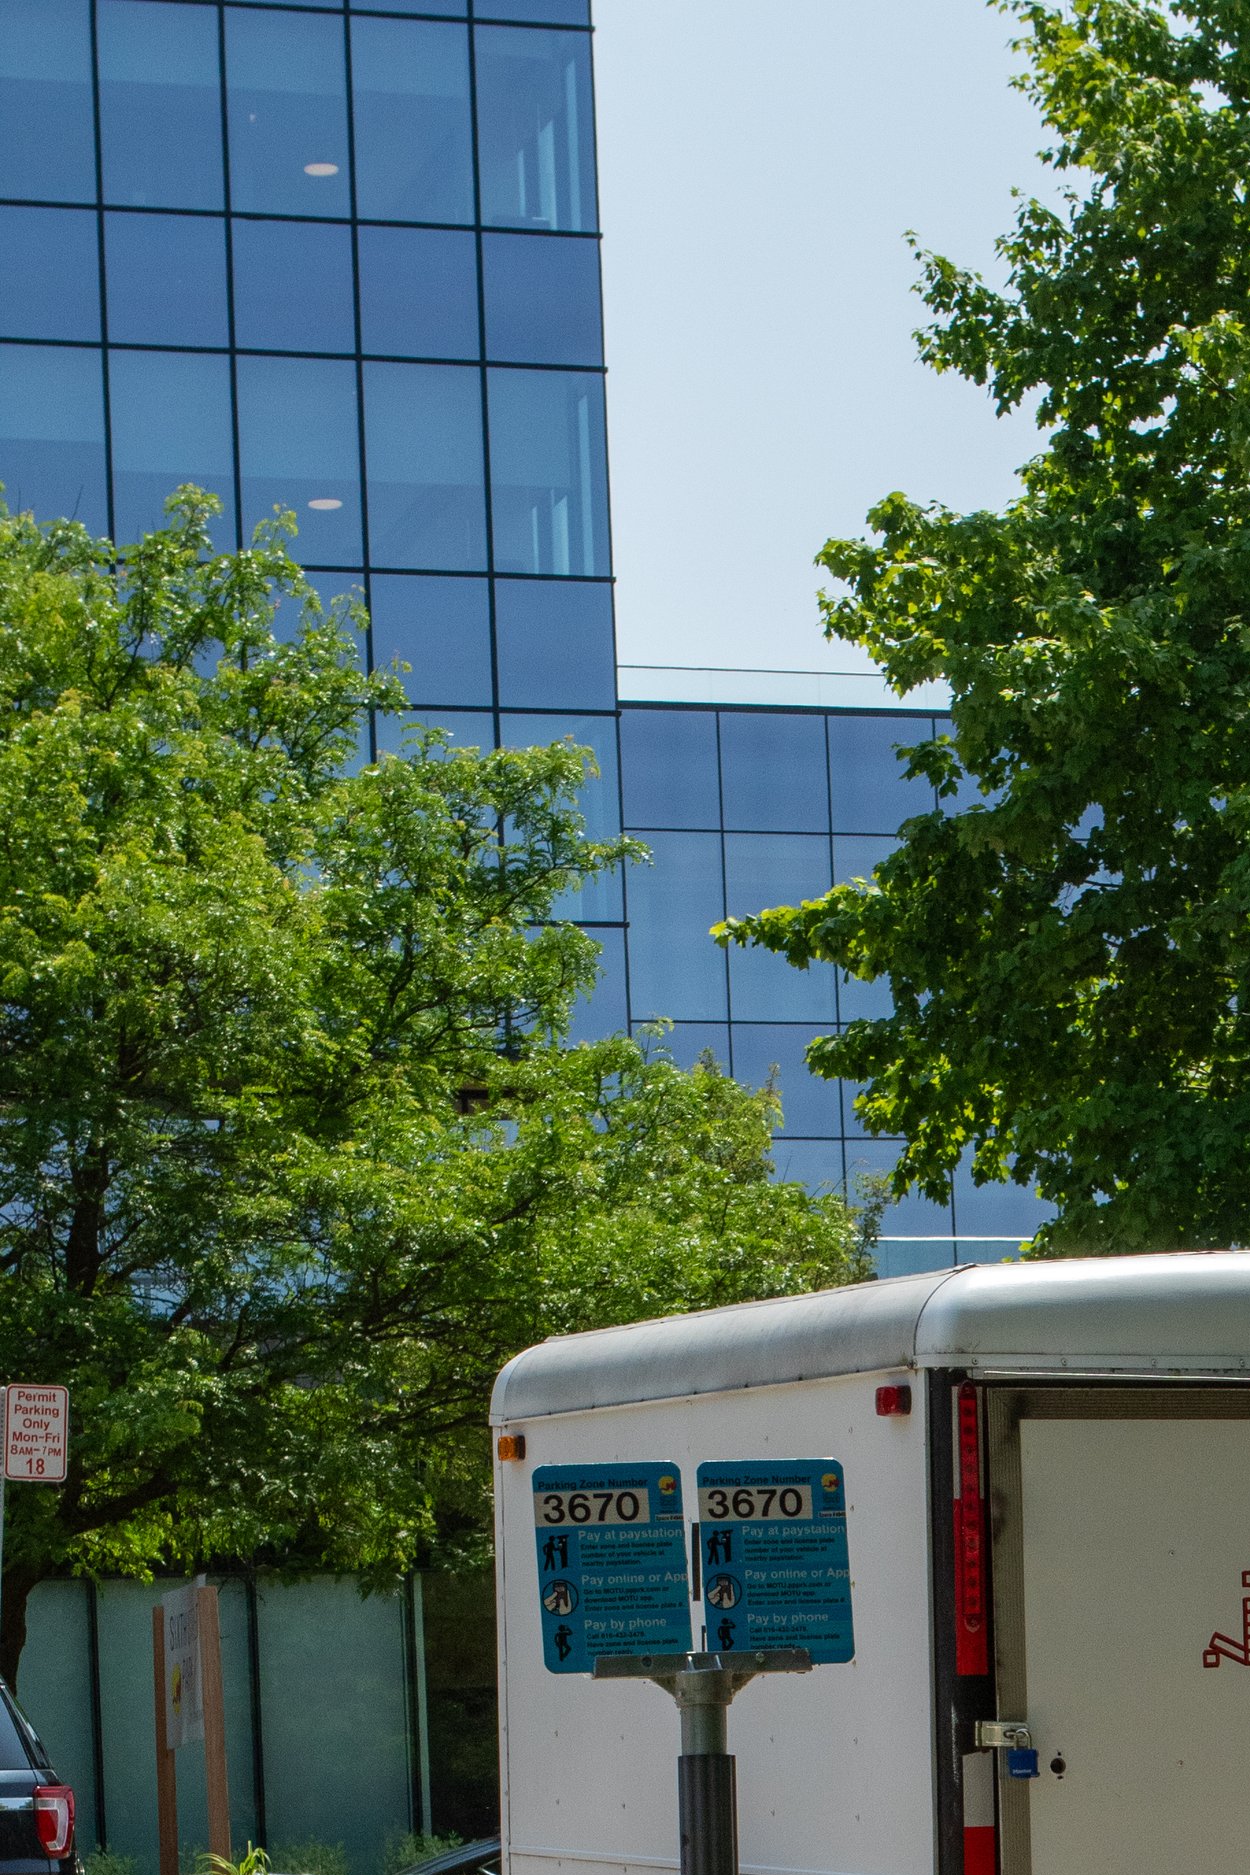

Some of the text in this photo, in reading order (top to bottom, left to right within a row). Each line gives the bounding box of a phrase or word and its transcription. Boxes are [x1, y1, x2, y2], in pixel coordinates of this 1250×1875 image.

[18, 1391, 56, 1402] Permit
[14, 1404, 60, 1418] Parking
[22, 1418, 50, 1430] Only
[12, 1431, 60, 1443] Mon-Fri
[26, 1458, 45, 1474] 18
[538, 1478, 648, 1491] Parking Zone Number
[703, 1475, 811, 1486] Parking Zone Number
[543, 1491, 640, 1523] 3670
[708, 1488, 803, 1519] 3670
[578, 1527, 683, 1542] Pay at paystation
[742, 1524, 846, 1538] Pay at paystation
[581, 1572, 689, 1586] Pay online or App
[745, 1567, 850, 1581] Pay online or App
[584, 1618, 667, 1631] Pay by phone
[747, 1612, 828, 1625] Pay by phone
